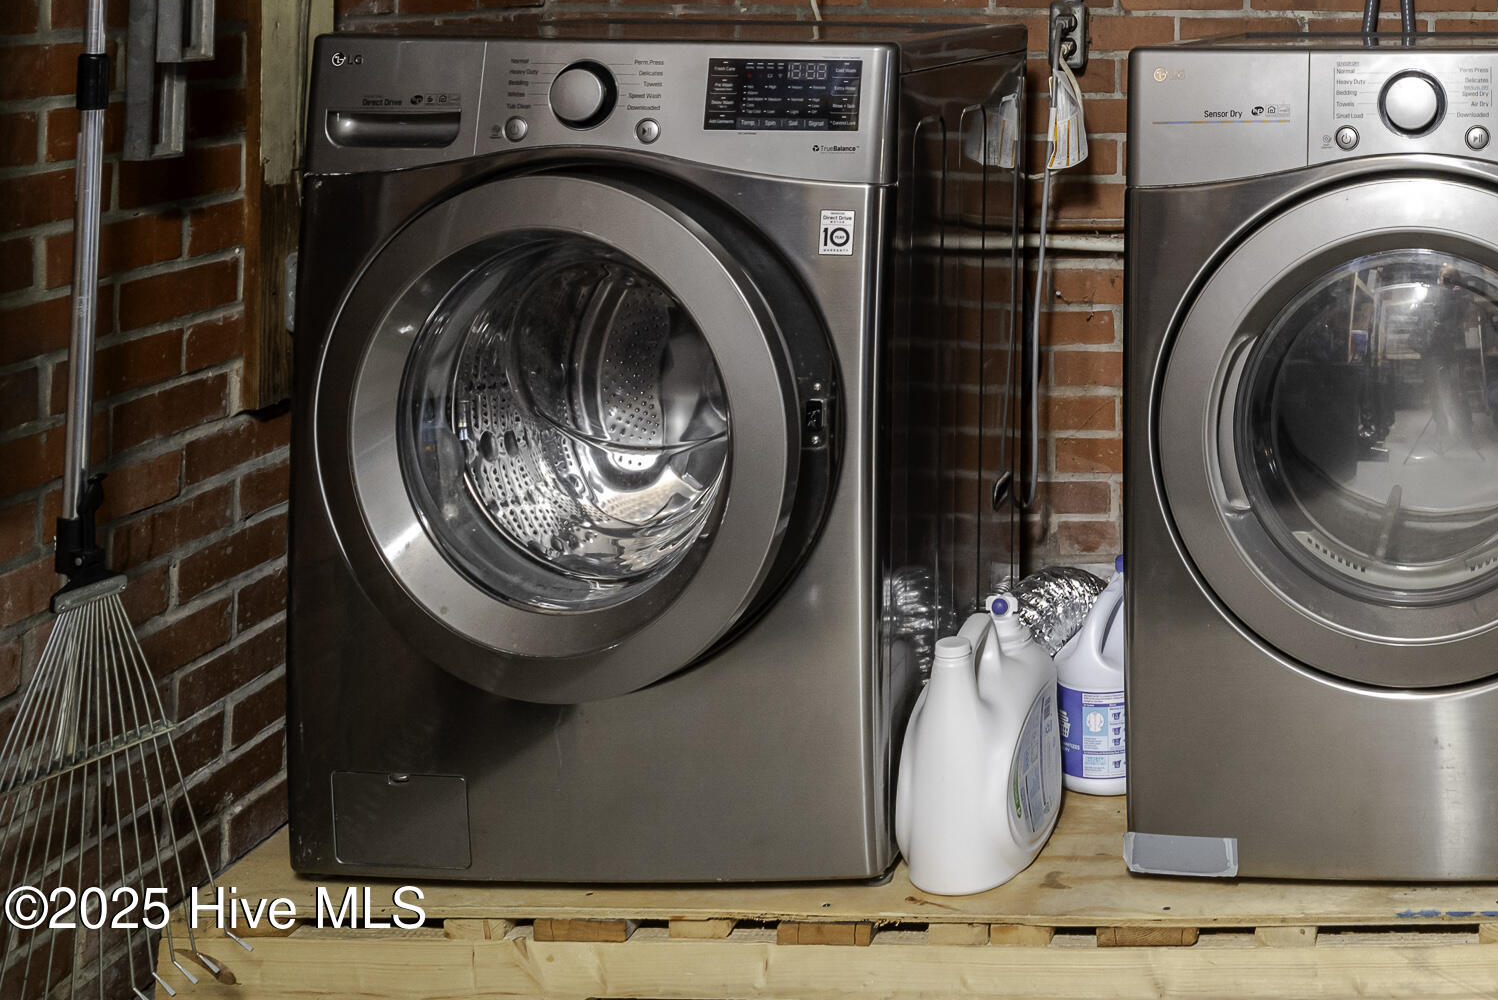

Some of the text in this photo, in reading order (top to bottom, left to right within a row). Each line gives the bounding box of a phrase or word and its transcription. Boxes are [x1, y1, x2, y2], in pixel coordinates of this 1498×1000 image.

[1204, 110, 1243, 119] Sensor Dry
[822, 227, 850, 247] 10
